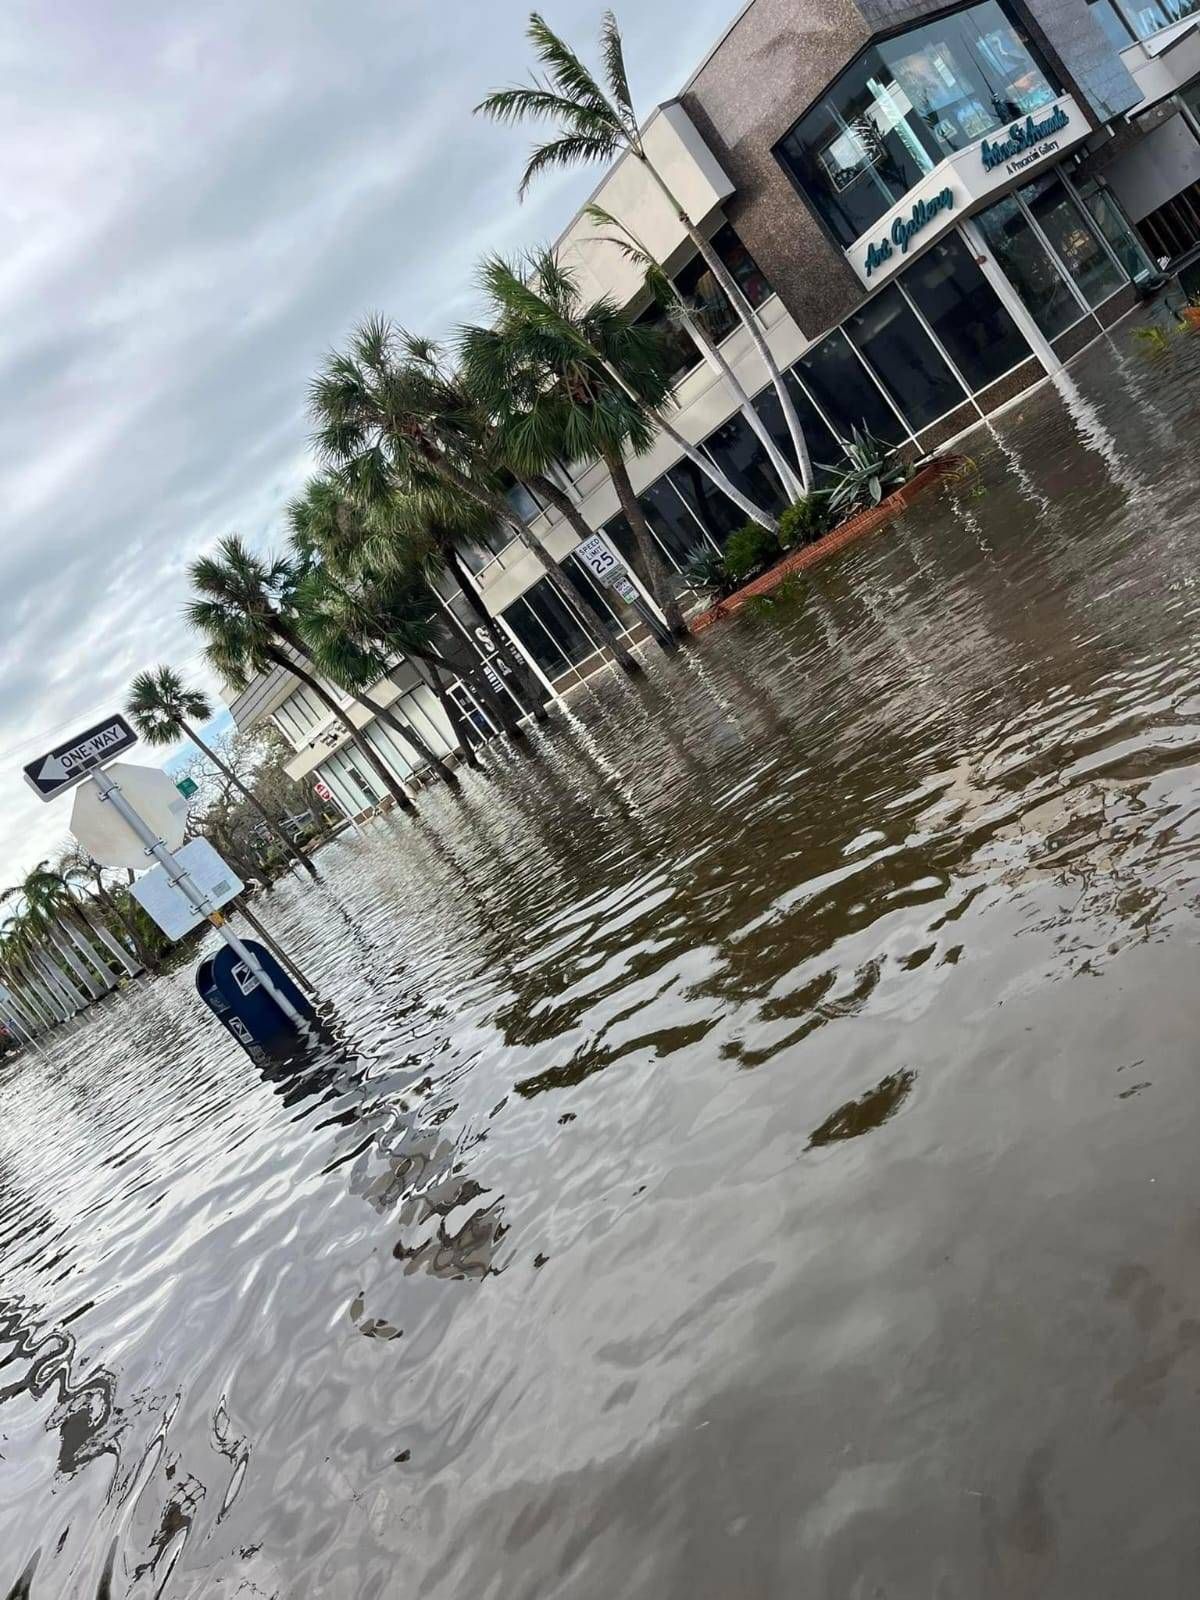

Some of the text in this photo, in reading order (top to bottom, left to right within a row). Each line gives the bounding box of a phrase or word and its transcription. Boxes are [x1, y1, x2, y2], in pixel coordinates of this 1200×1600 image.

[865, 187, 953, 277] Art Gallery
[579, 538, 600, 555] SPEED
[586, 546, 602, 561] LIMIT
[590, 551, 614, 574] 25
[61, 727, 119, 768] ONE WAY
